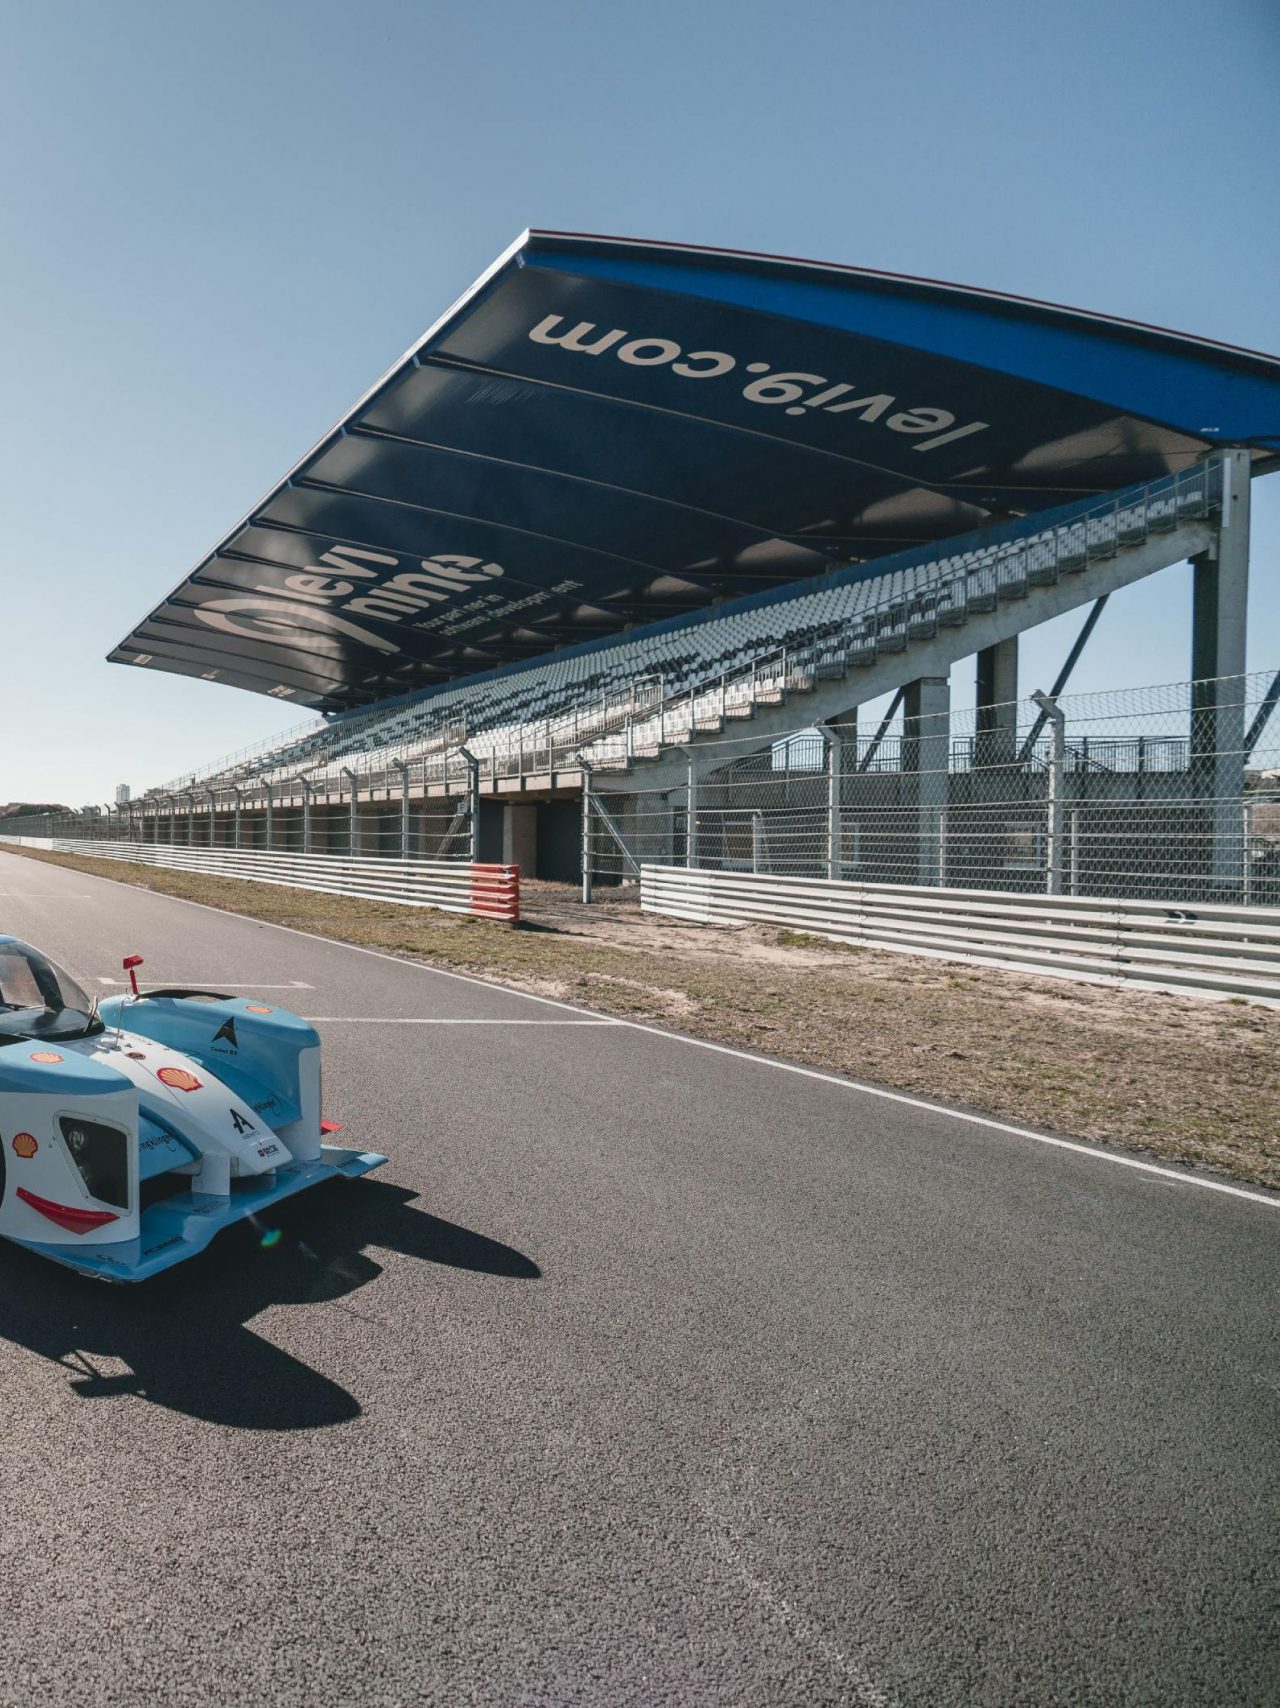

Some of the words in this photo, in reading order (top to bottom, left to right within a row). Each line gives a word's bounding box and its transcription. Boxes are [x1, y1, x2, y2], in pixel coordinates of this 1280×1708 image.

[528, 313, 990, 452] levi9.com
[254, 545, 400, 606] levi
[340, 554, 505, 622] nine
